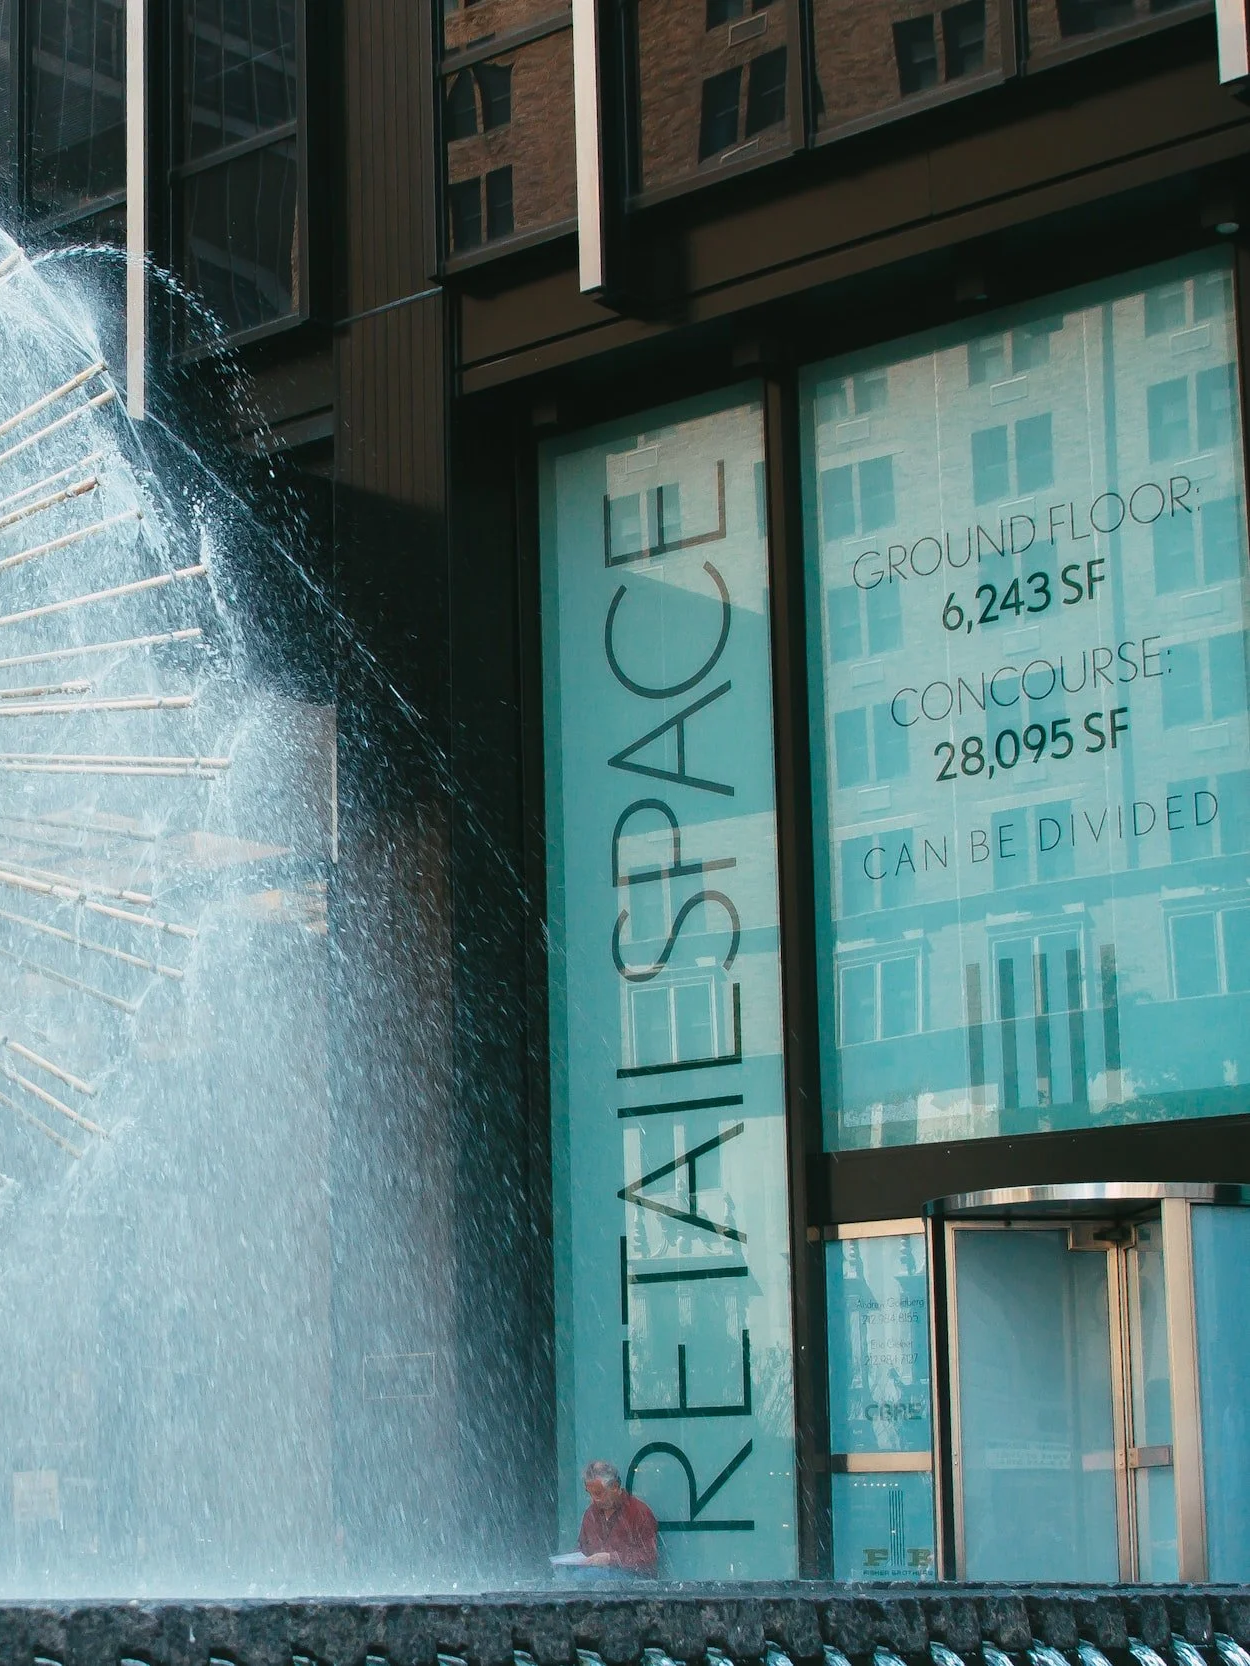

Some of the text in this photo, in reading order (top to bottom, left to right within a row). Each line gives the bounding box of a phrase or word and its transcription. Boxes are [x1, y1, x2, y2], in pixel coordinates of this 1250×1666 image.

[852, 475, 1201, 590] GROUND FLOOR:
[941, 558, 1106, 635] 6,243 SF
[890, 635, 1173, 728] CONCOURSE:
[933, 706, 1129, 782] 28,095 SF
[863, 791, 1219, 880] CAN BE DIVIDED
[603, 459, 755, 1531] RETAIL SPACE
[864, 1402, 923, 1421] CBRE
